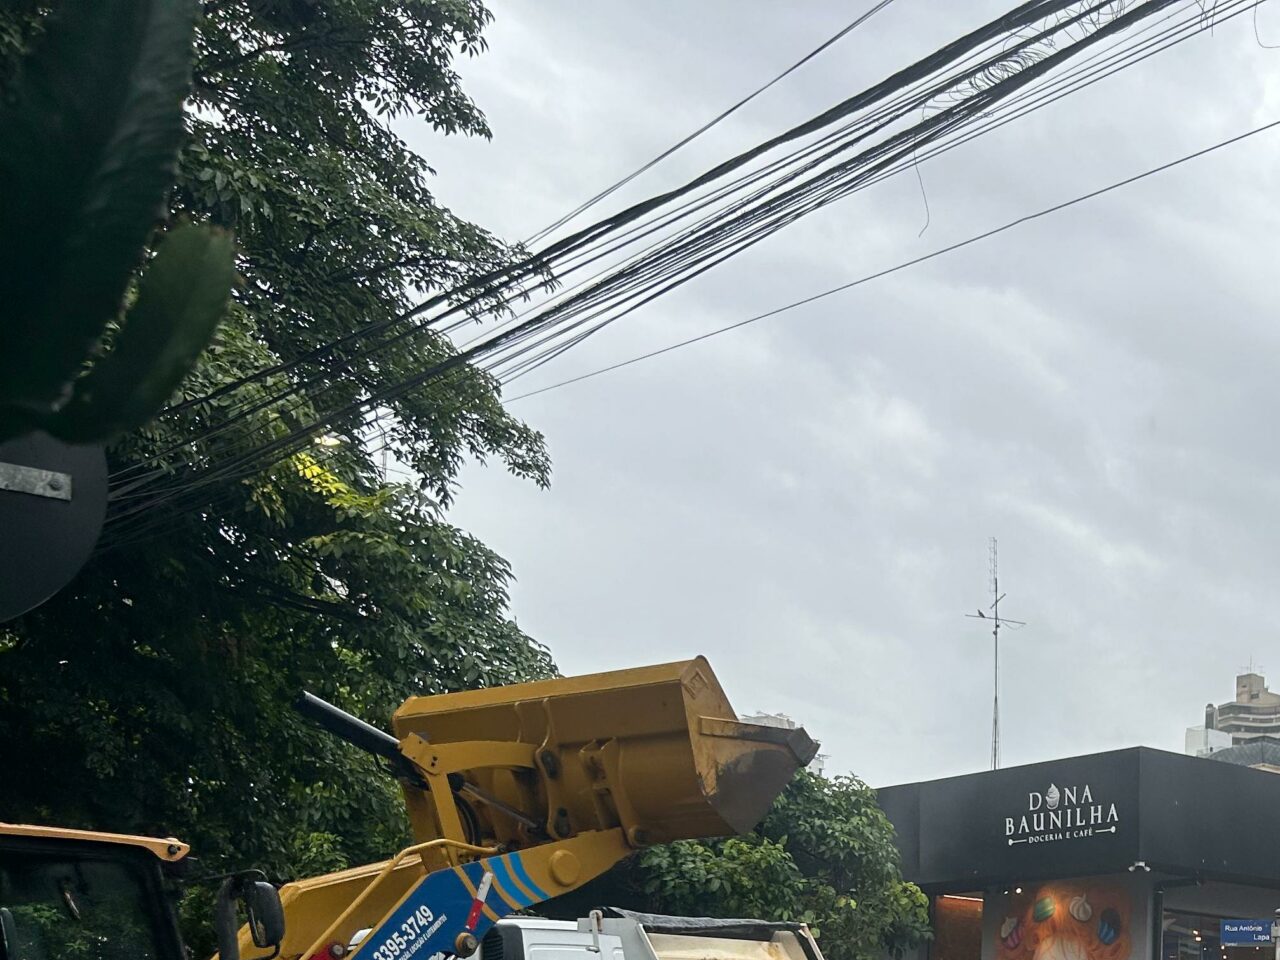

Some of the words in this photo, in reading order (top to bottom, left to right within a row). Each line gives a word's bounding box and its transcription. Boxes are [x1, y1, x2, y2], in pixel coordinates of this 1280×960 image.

[1005, 803, 1119, 836] BAUNILHA
[1029, 833, 1063, 844] DOCERIA
[1066, 831, 1071, 839] E
[1073, 827, 1093, 838] CAFÉ
